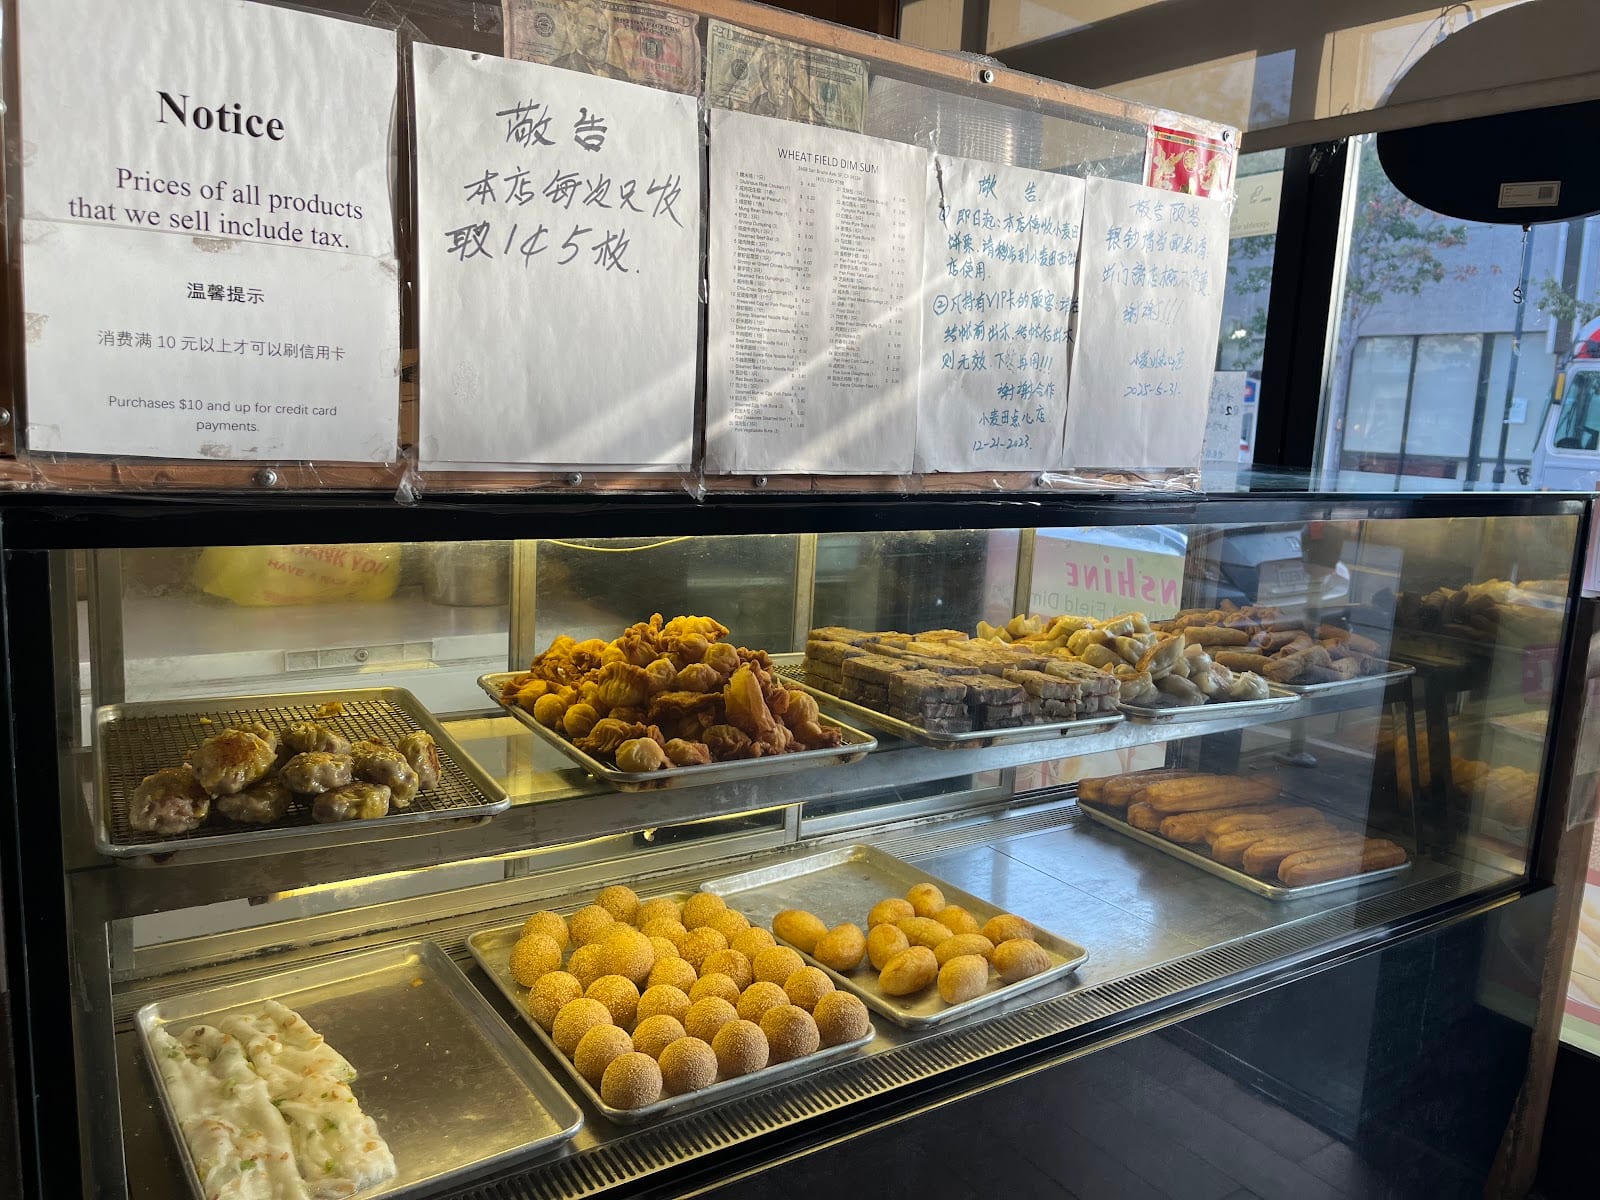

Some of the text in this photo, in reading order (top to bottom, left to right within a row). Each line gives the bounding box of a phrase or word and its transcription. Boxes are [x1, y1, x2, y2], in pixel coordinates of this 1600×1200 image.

[155, 90, 286, 142] Notice
[777, 146, 880, 175] WHEAT FIELD DIM SUM
[116, 167, 364, 221] Prices of all products
[68, 197, 350, 249] that we sell include tax.
[186, 281, 265, 304] 温馨提示
[97, 329, 346, 362] 消费满 10 元以上才可以刷信用卡
[108, 395, 337, 417] Purchases $10 and up for credit card
[195, 418, 260, 434] payments.
